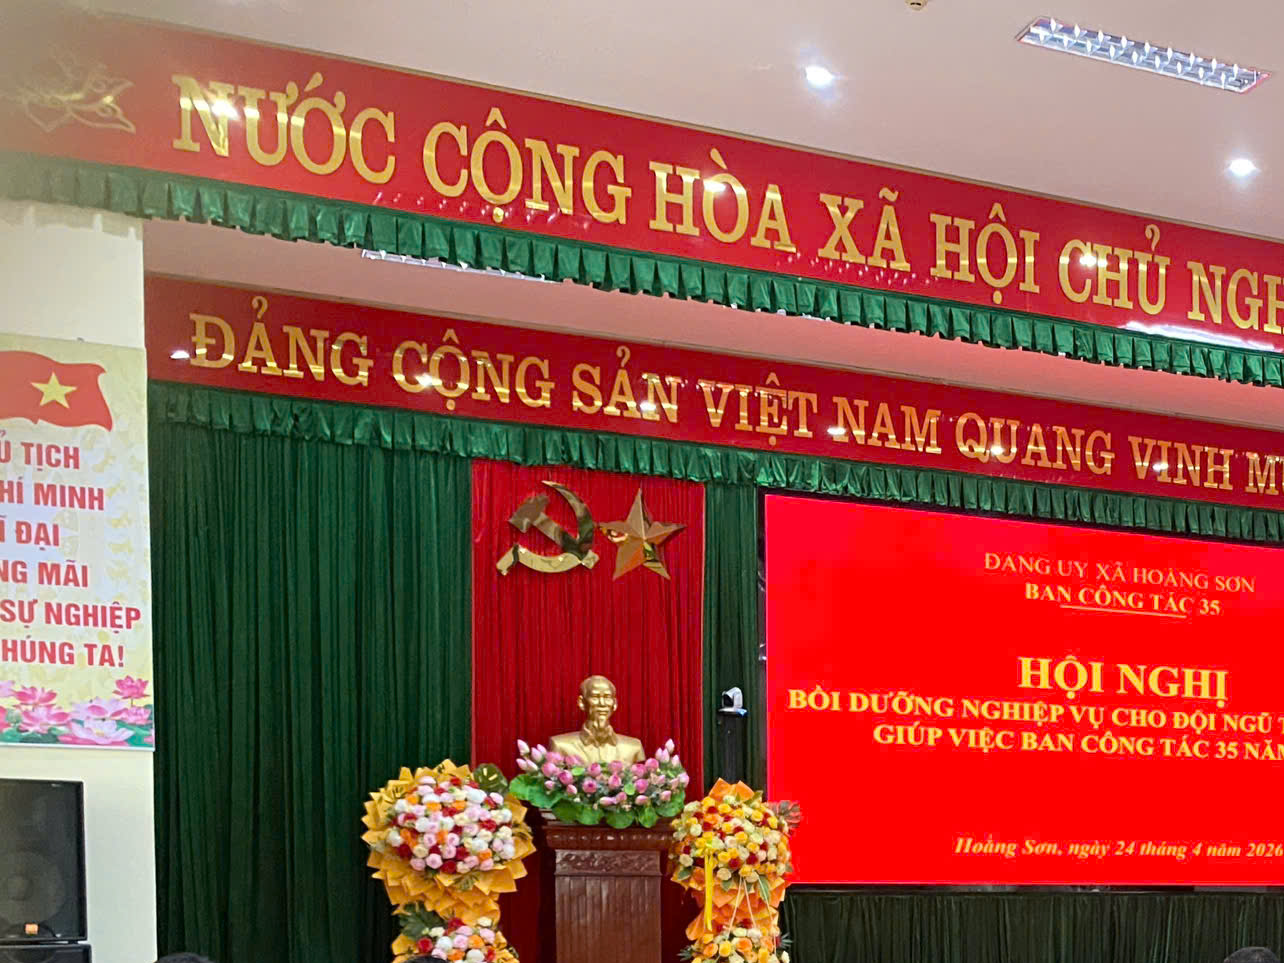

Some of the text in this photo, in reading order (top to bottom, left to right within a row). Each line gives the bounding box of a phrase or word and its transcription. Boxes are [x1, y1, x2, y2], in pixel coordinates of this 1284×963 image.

[171, 72, 396, 184] NƯỚC
[422, 107, 632, 223] CỘNG
[648, 148, 797, 254] HÒA
[817, 187, 911, 272] XÃ
[929, 203, 1041, 305] HỘI
[1058, 224, 1171, 316] CHỦ
[189, 295, 374, 387] ĐẢNG
[392, 328, 555, 412] CỘNG
[572, 345, 679, 423] SẢN
[698, 372, 818, 446] VIỆT
[832, 397, 942, 454] NAM
[955, 411, 1116, 476] QUANG
[1128, 435, 1235, 490] VINH
[20, 441, 80, 472] TỊCH
[33, 482, 105, 511] MINH
[15, 520, 60, 551] ĐẠI
[37, 559, 89, 588] MÃI
[1096, 561, 1126, 584] XÃ
[1215, 576, 1256, 593] SƠN
[1025, 582, 1220, 616] BAN CÔNG TÁC 35
[0, 598, 142, 634] SỰ NGHIỆP
[83, 643, 124, 668] TA!
[1017, 655, 1229, 708] HỘI NGHỊ
[849, 691, 954, 717] DƯỠNG
[962, 699, 1065, 727] NGHIỆP
[1070, 704, 1104, 729] VỤ
[1111, 706, 1167, 728] CHO
[1172, 709, 1217, 735] ĐỘI
[1223, 711, 1272, 734] NGŨ
[873, 720, 943, 747] GIÚP
[948, 726, 1015, 753] VIỆC
[1021, 731, 1074, 752] BAN
[1080, 731, 1154, 756] CÔNG
[1160, 735, 1209, 758] TÁC
[1214, 740, 1238, 759] 35
[1114, 840, 1135, 856] 24
[1139, 840, 1187, 860] tháng
[1192, 841, 1202, 856] 4
[1246, 842, 1284, 857] 2026
